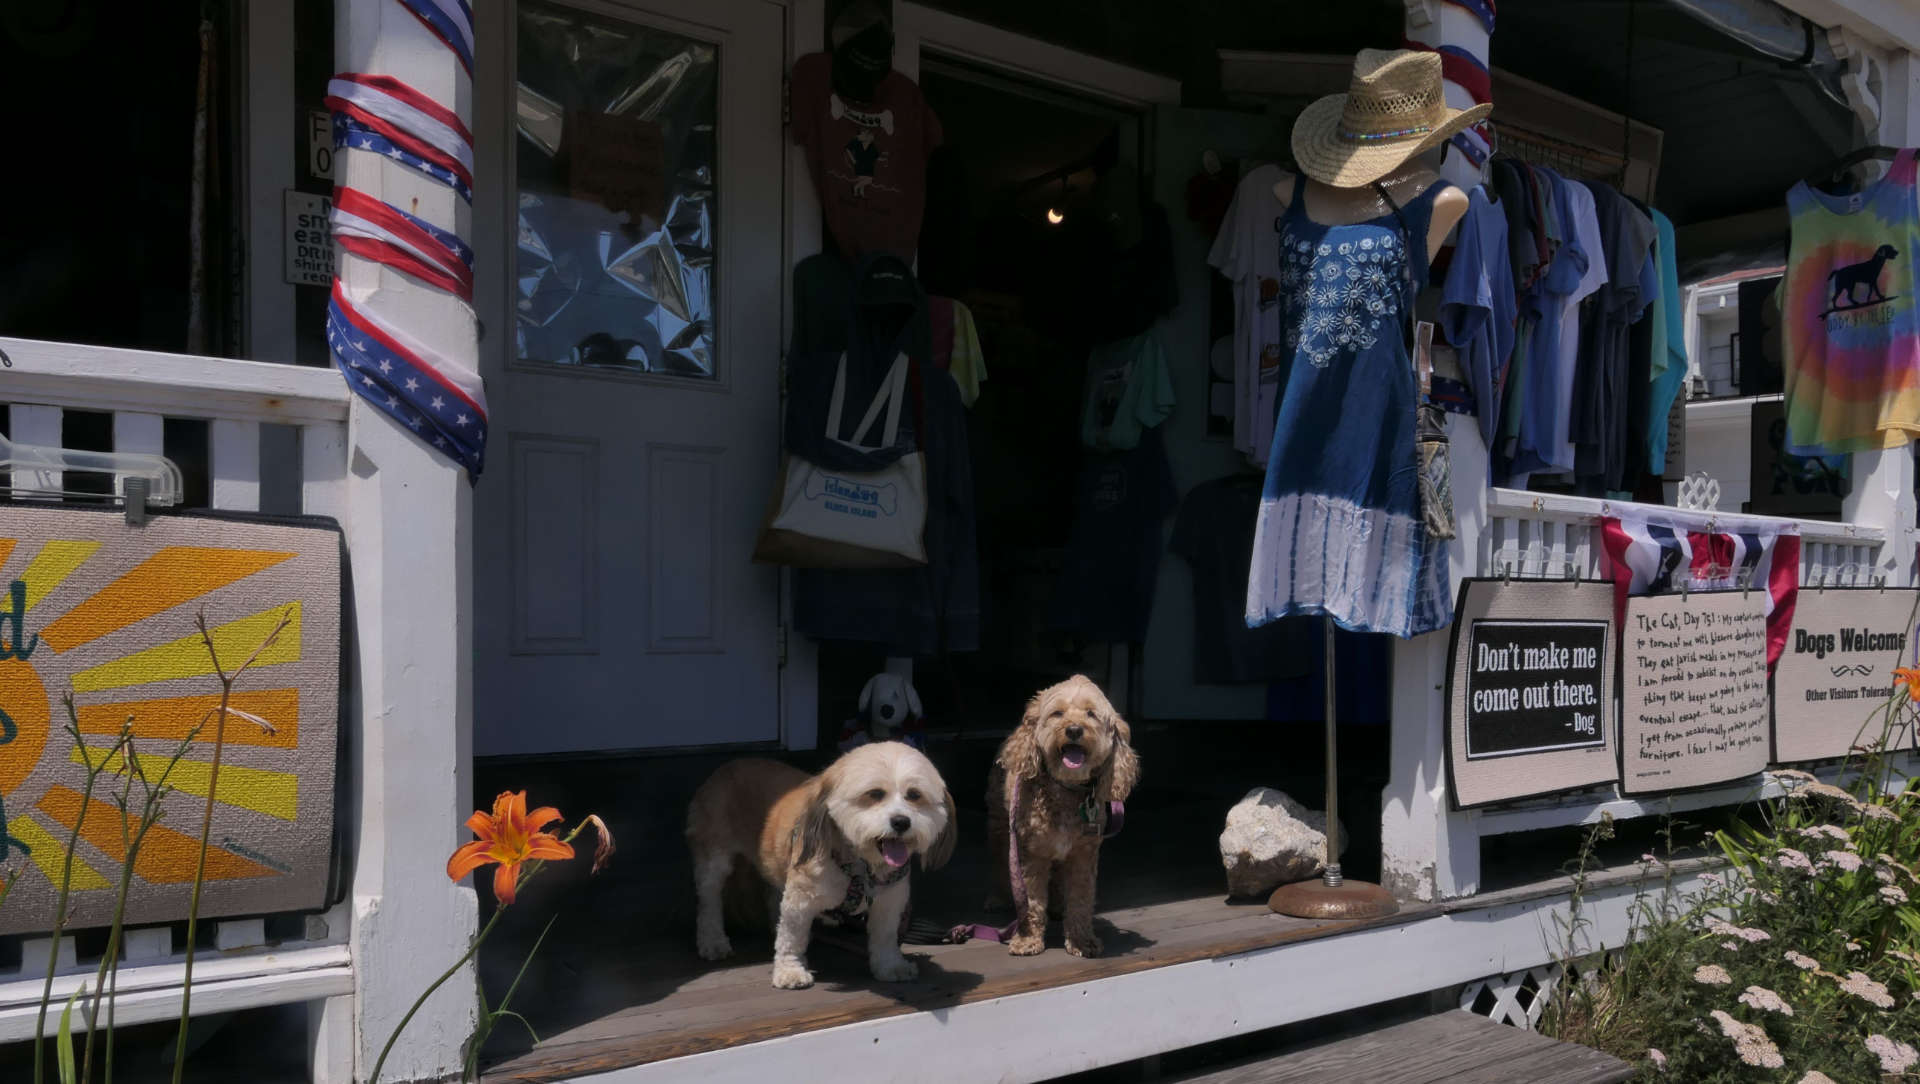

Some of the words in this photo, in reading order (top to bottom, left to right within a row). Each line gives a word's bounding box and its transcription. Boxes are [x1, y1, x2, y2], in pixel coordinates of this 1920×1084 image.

[1636, 614, 1657, 633] The
[1661, 612, 1681, 631] Cat,
[1684, 611, 1700, 630] Day
[1722, 614, 1732, 626] My
[1637, 638, 1645, 650] to
[1650, 635, 1680, 648] torment
[1694, 633, 1709, 645] with
[1710, 631, 1733, 645] bizarre
[1795, 628, 1835, 660] Dogs
[1840, 628, 1905, 652] Welcome
[1476, 642, 1520, 672] Don't
[1523, 641, 1569, 670] make
[1572, 646, 1597, 668] me
[1637, 655, 1656, 672] They
[1661, 656, 1673, 669] eat
[1699, 649, 1718, 661] meals
[1638, 674, 1642, 687] I
[1644, 678, 1658, 687] am
[1687, 671, 1694, 681] to
[1473, 687, 1519, 713] come
[1523, 681, 1550, 709] out
[1552, 679, 1597, 707] there.
[1644, 692, 1665, 707] thing
[1669, 690, 1685, 702] that
[1688, 690, 1706, 704] keeps
[1806, 689, 1827, 702] Other
[1830, 687, 1858, 700] Visitors
[1639, 711, 1674, 726] eventual
[1640, 733, 1643, 745] I
[1646, 734, 1661, 748] get
[1664, 731, 1683, 743] from
[1686, 723, 1727, 740] occasionally
[1693, 743, 1706, 754] fear
[1714, 741, 1728, 753] may
